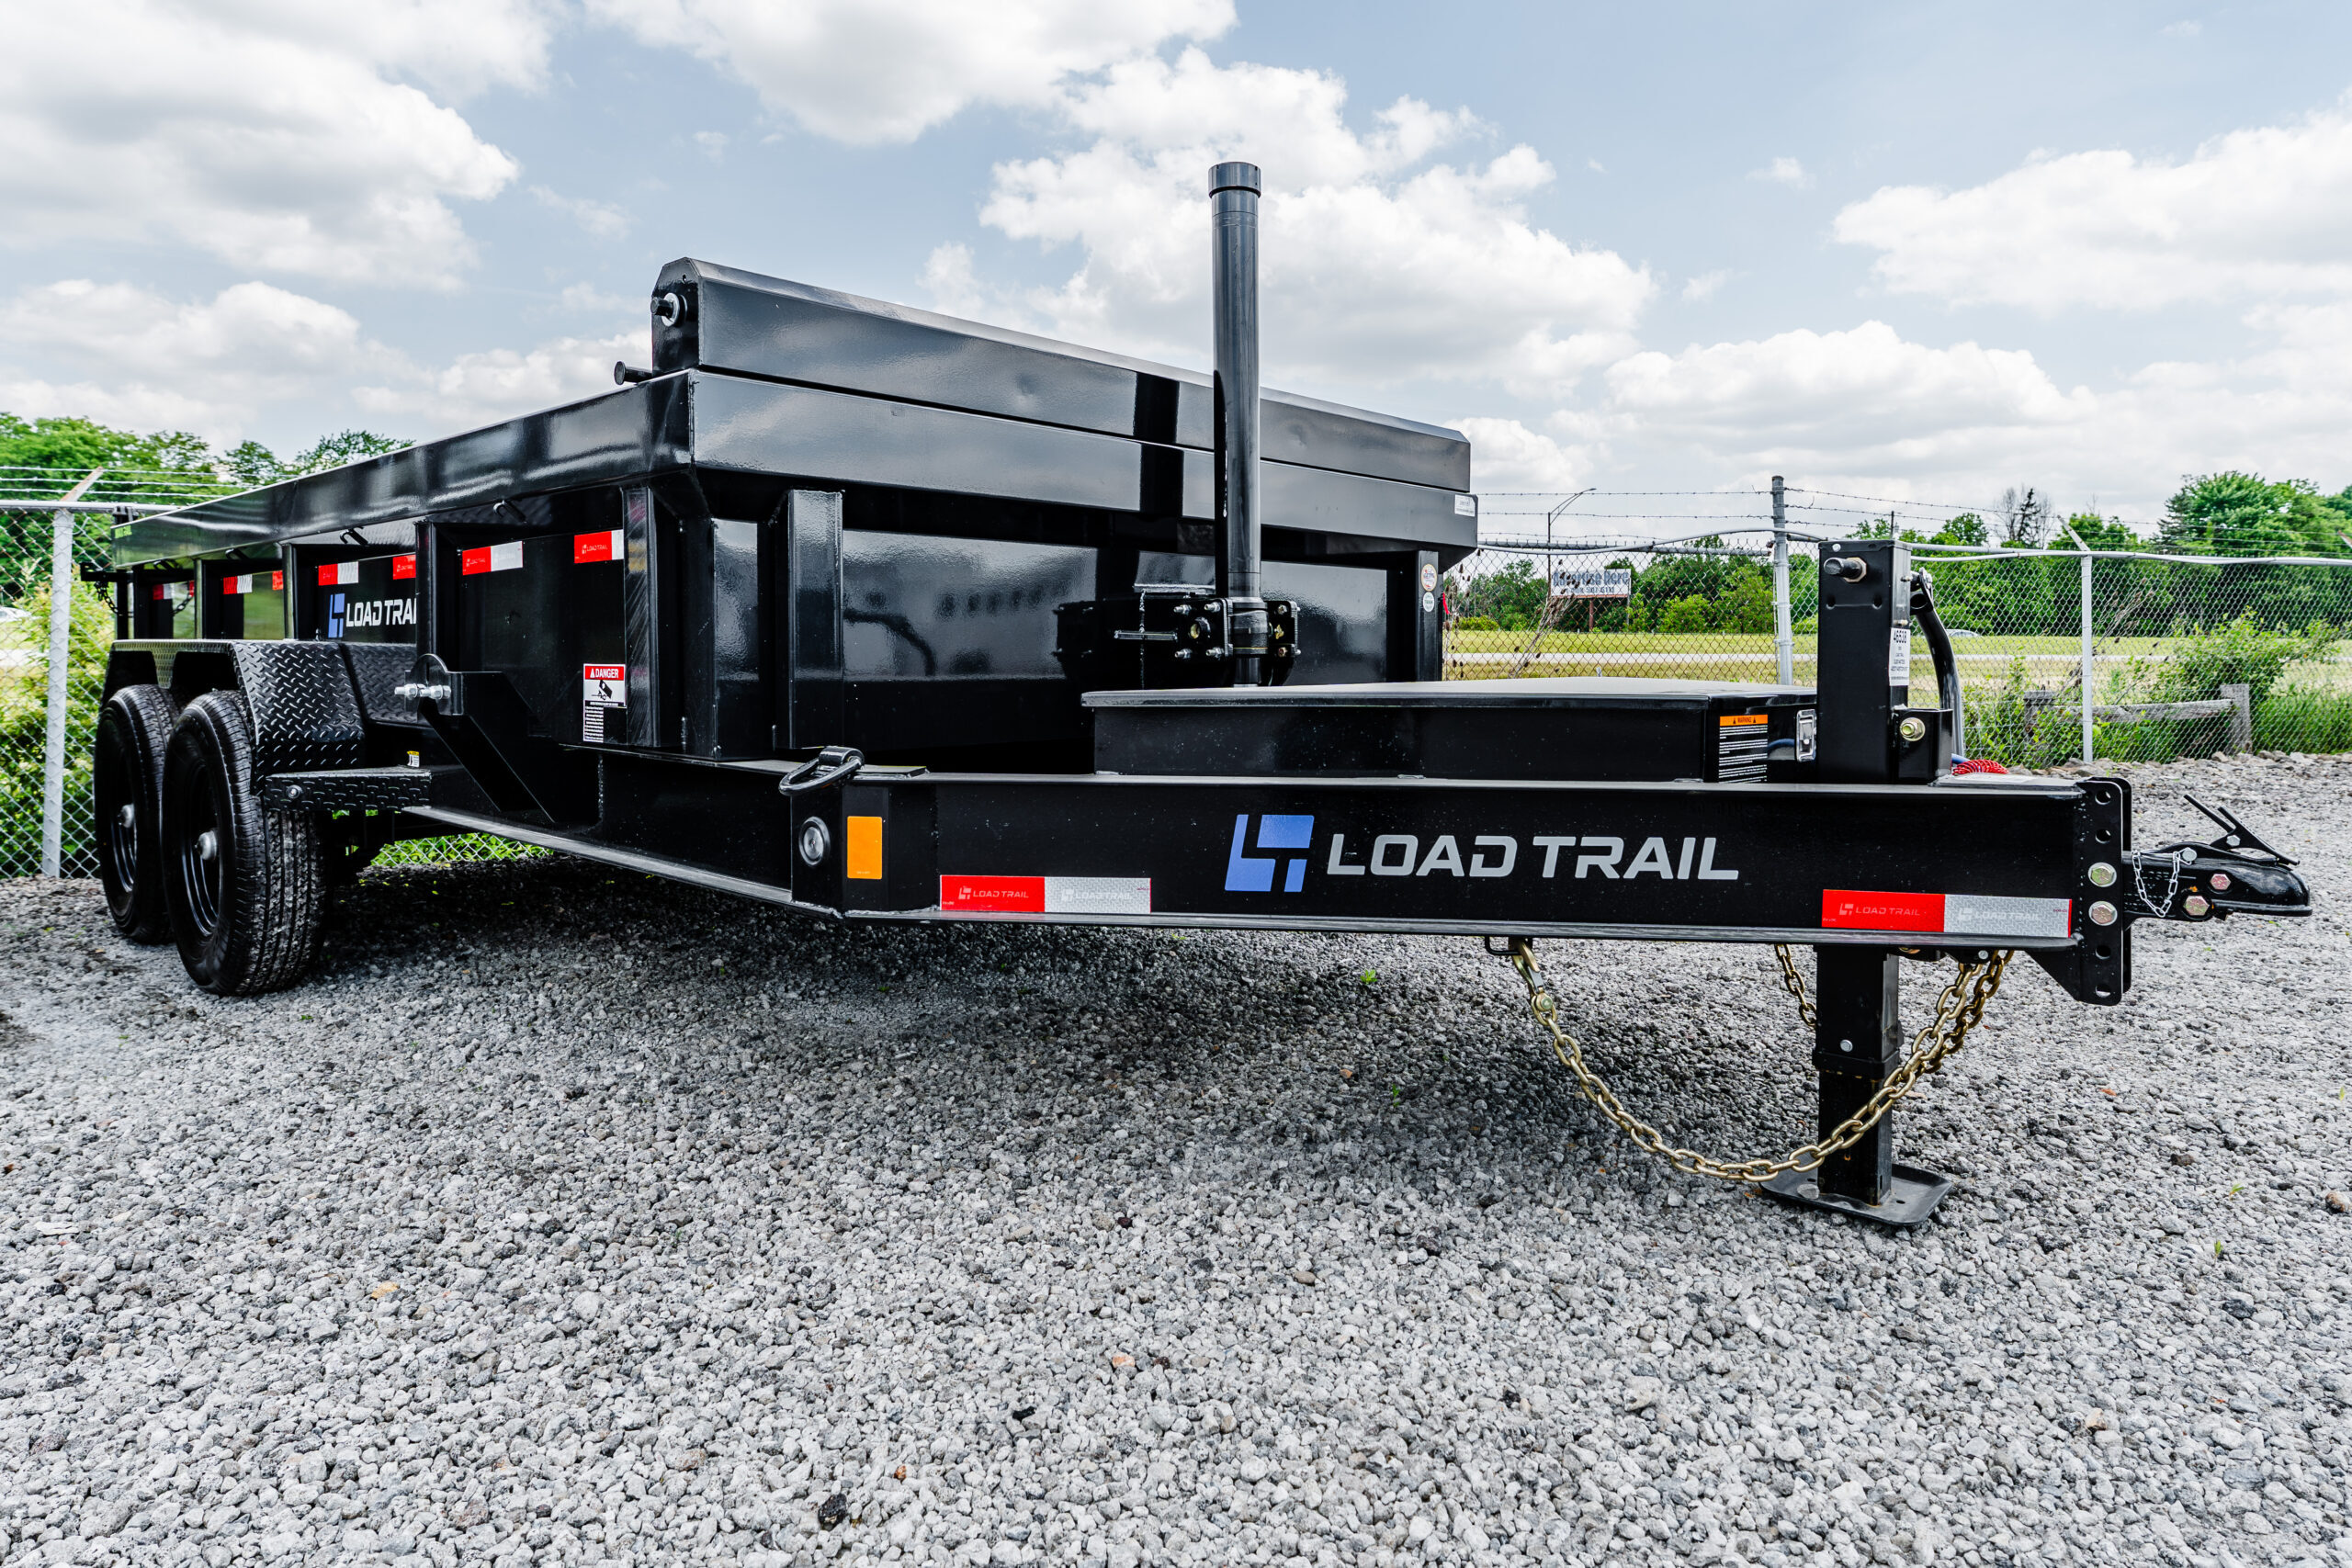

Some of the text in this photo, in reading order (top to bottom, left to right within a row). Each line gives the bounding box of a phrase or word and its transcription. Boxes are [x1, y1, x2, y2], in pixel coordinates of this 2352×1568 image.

[346, 598, 417, 627] LOAD TRAI
[595, 668, 619, 679] DANGER
[1327, 833, 1739, 880] LOAD TRAIL
[1855, 907, 1920, 916] LOAD TRAIL
